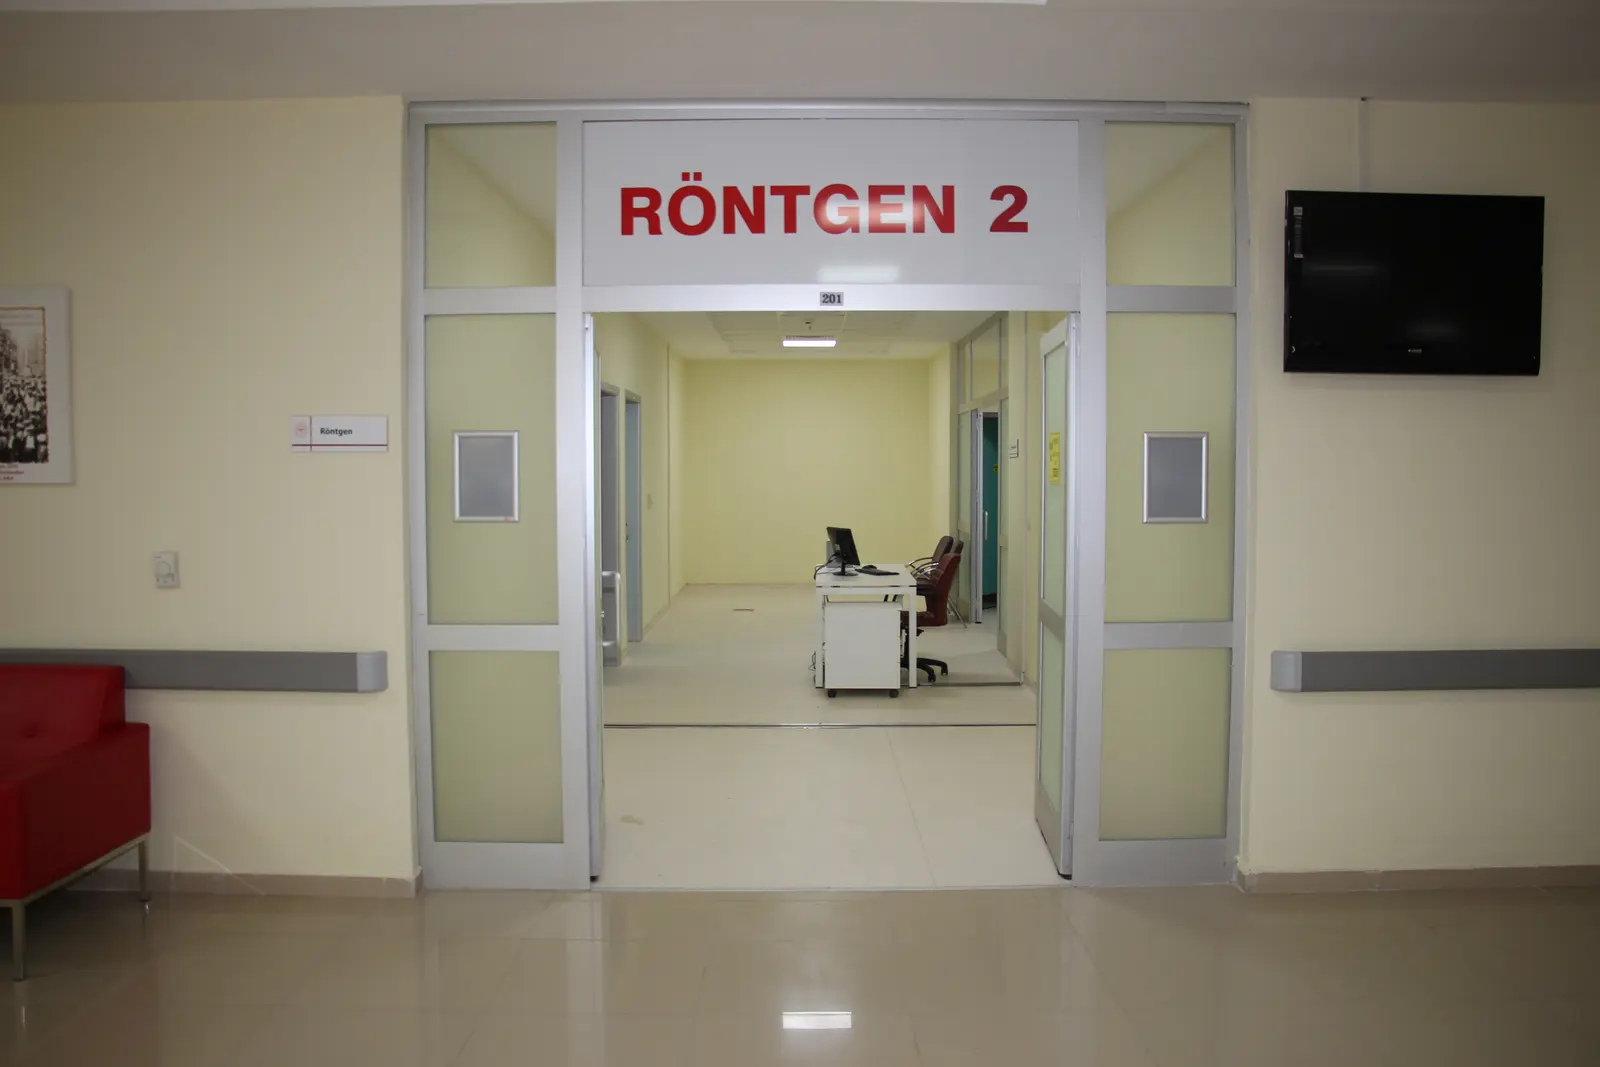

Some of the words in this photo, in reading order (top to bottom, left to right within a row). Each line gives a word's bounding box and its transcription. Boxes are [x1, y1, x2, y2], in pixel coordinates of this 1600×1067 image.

[620, 171, 956, 236] RÖNTGEN
[989, 185, 1029, 233] 2
[822, 293, 842, 304] 201
[320, 427, 353, 437] Röntgen
